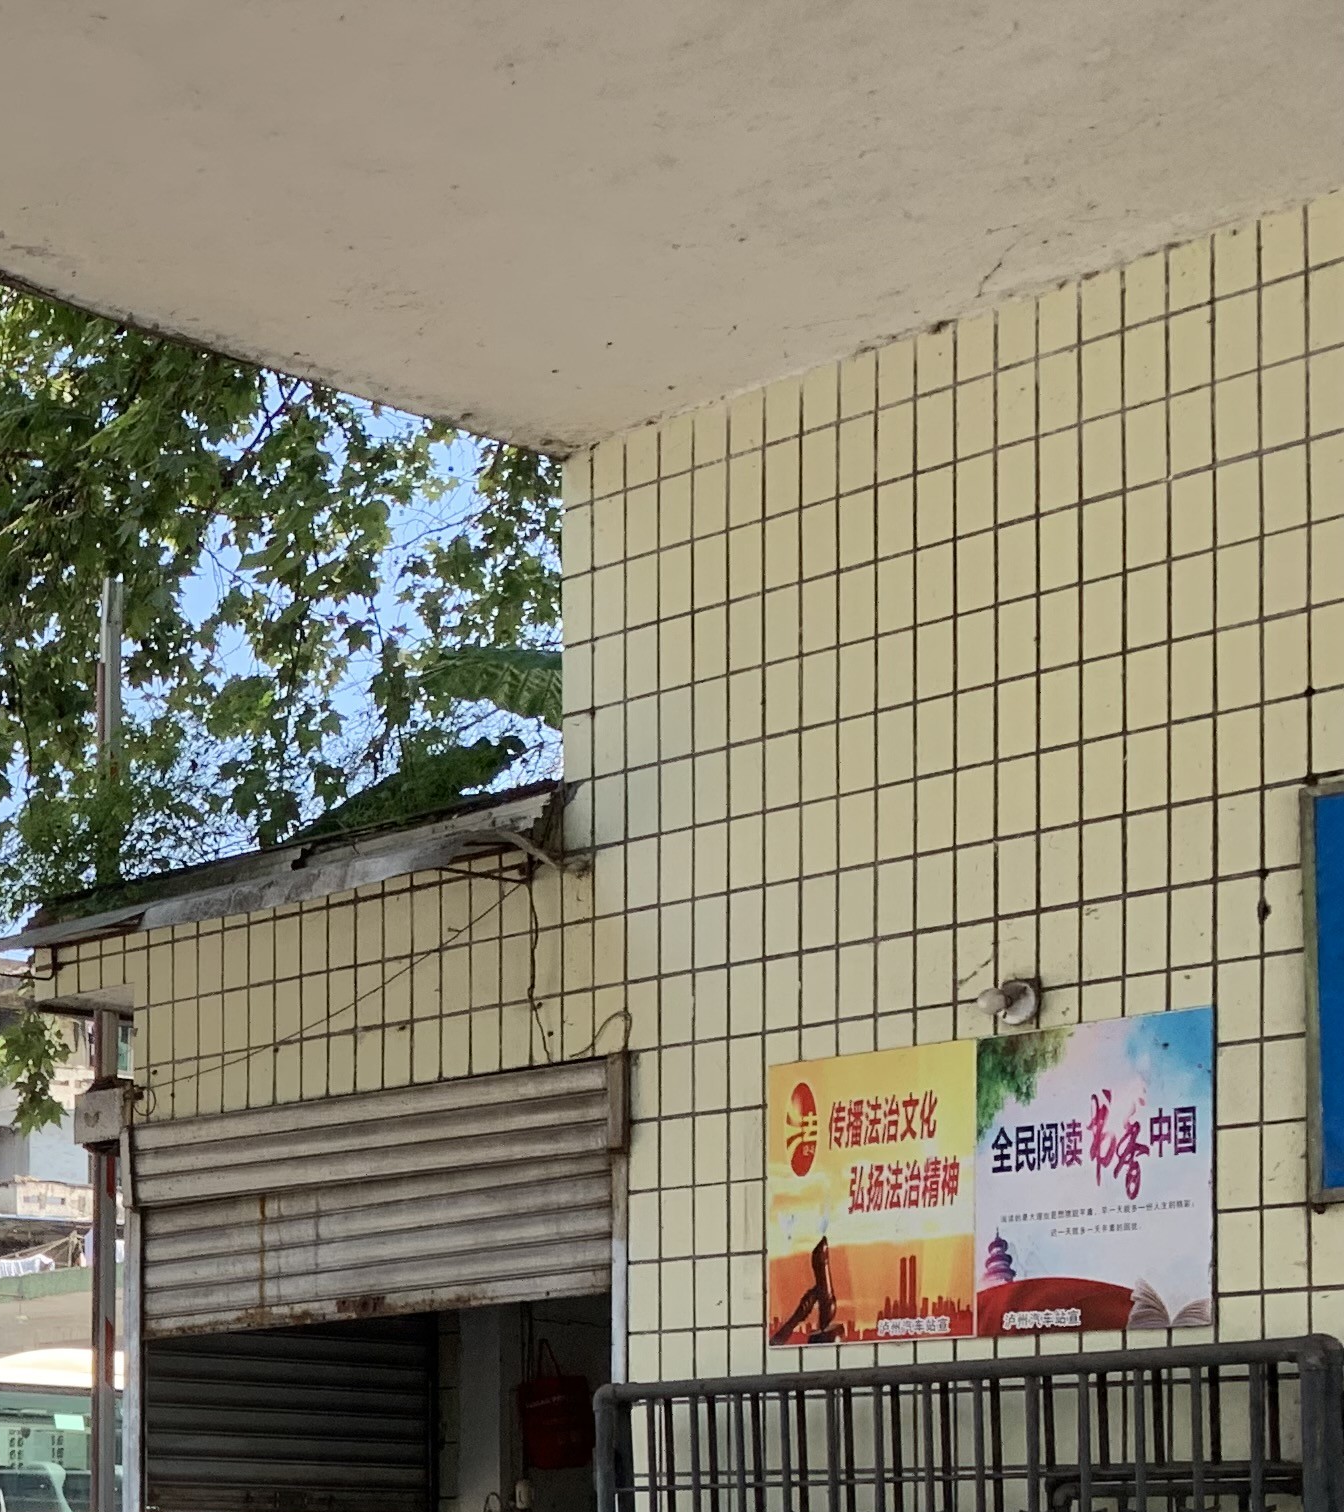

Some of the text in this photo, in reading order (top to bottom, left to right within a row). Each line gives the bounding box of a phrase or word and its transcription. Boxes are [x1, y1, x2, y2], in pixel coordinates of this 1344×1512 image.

[828, 1089, 938, 1150] 传播法治文化
[848, 1154, 960, 1214] 弘扬法治精神
[877, 1316, 951, 1336] 泸州汽车站宣
[1002, 1308, 1082, 1330] 泸州汽车站宣
